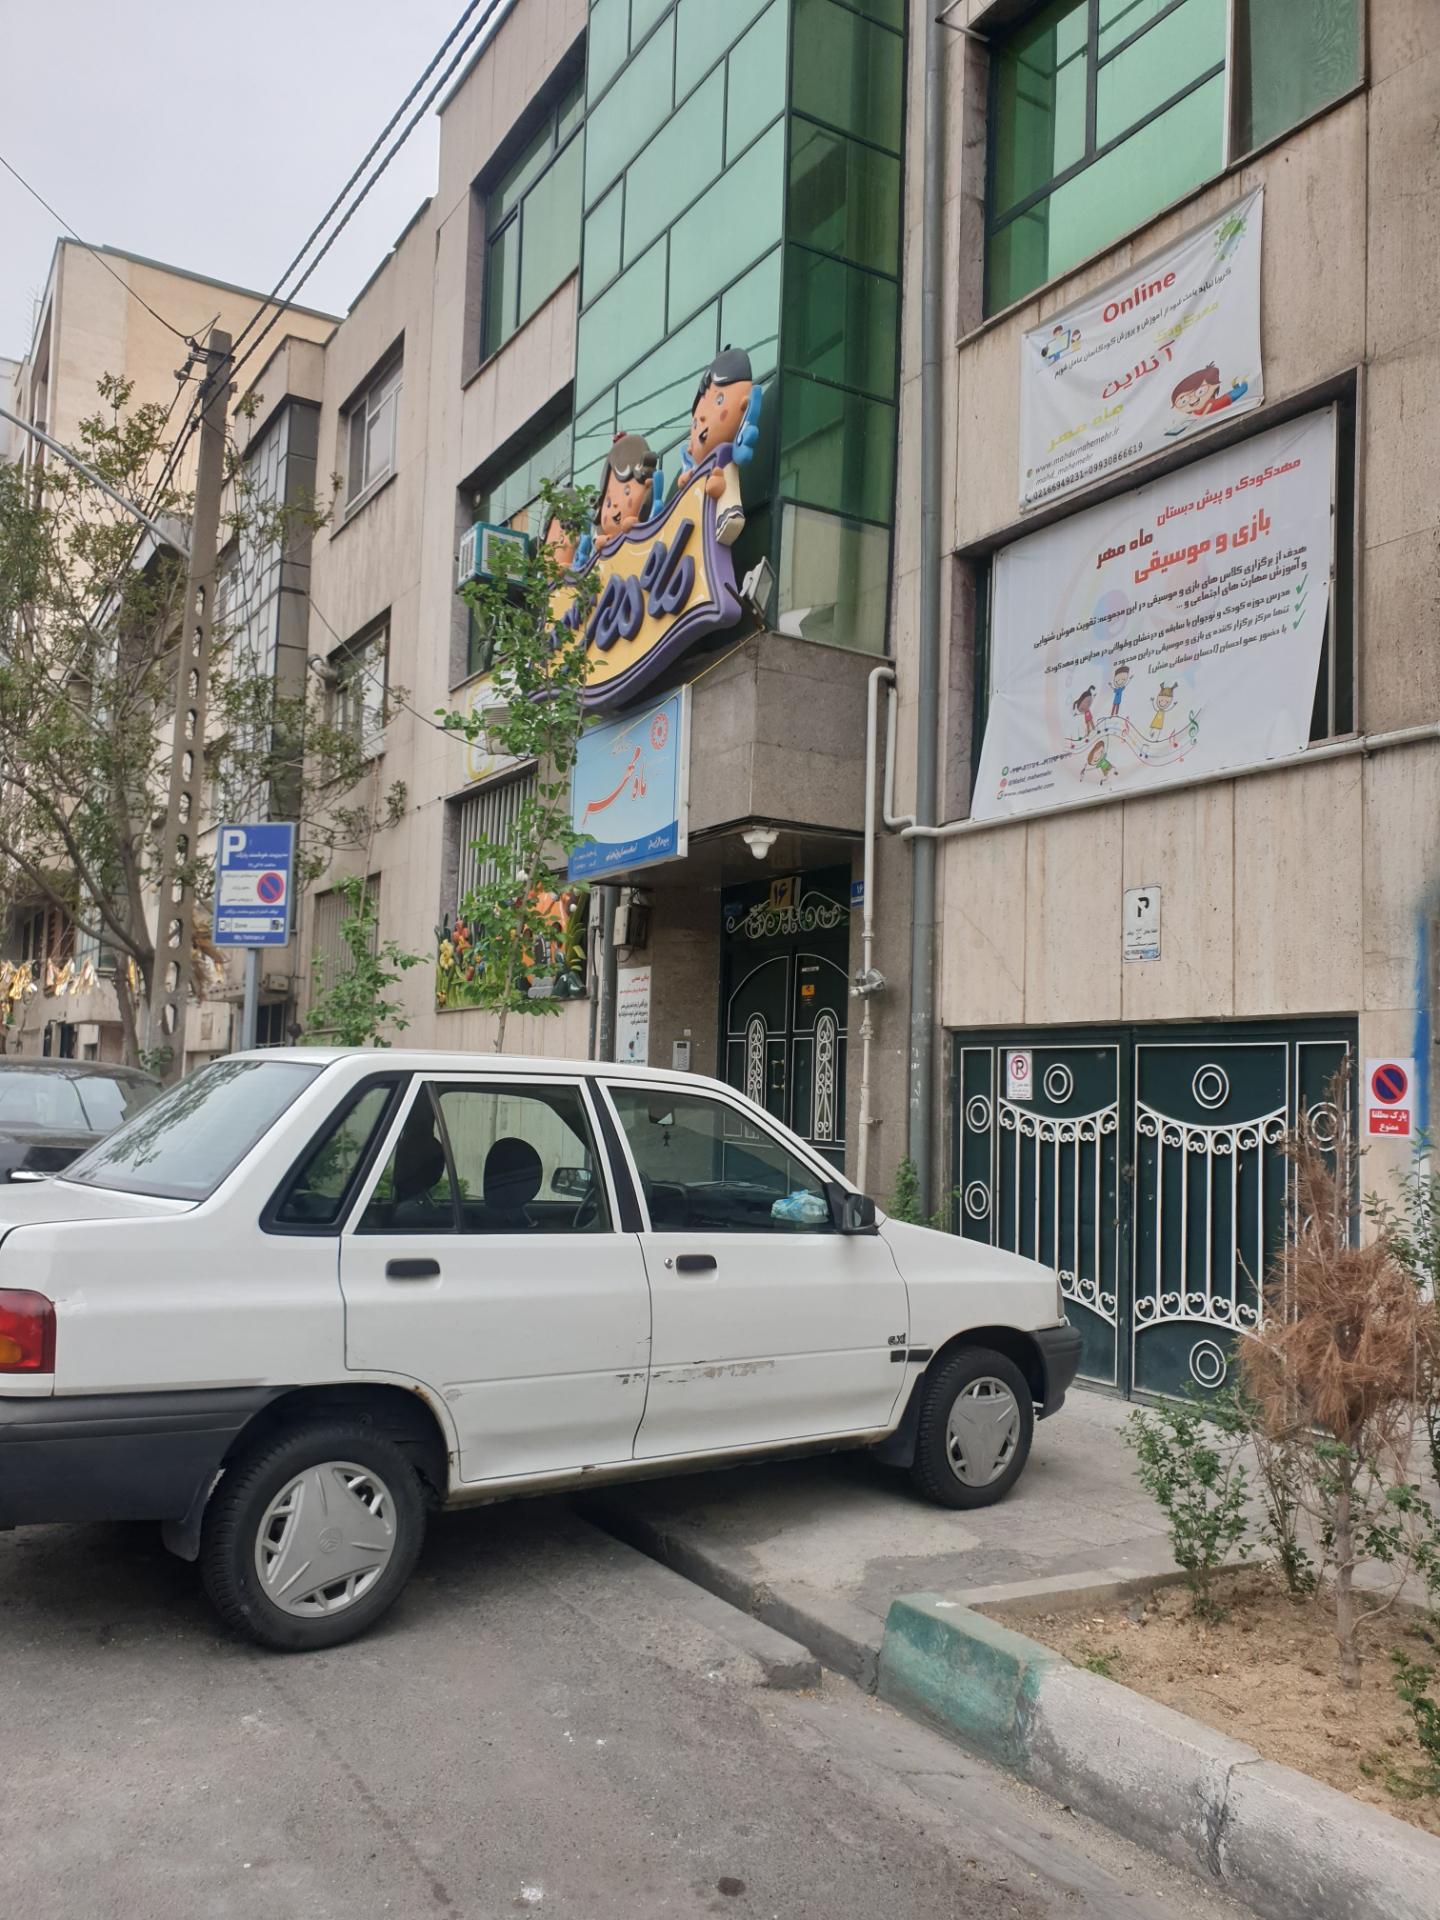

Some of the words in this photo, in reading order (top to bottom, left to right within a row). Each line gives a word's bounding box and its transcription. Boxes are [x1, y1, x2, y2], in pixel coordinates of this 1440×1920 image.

[1198, 281, 1213, 293] نباید
[1103, 272, 1175, 322] Online
[1141, 308, 1162, 329] آموزش
[1116, 328, 1135, 343] پرورش
[1102, 339, 1174, 398] آنلاین
[1092, 403, 1123, 424] ماه
[1049, 424, 1085, 451] مهر
[1235, 459, 1300, 490] مهدکودک
[1196, 489, 1222, 510] پیش
[1225, 486, 1232, 499] و
[1157, 502, 1193, 526] دبستان
[1232, 508, 1270, 547] بازی
[1129, 528, 1152, 550] ماه
[1215, 533, 1227, 554] و
[1096, 544, 1125, 569] مهر
[1275, 550, 1281, 564] از
[1283, 546, 1306, 558] هدف
[640, 518, 695, 619] ماه
[1134, 540, 1210, 583] موسیقی
[1243, 556, 1272, 574] برگزاری
[1269, 556, 1300, 580] آموزش
[1301, 561, 1307, 570] و
[1219, 565, 1242, 583] کلاس
[1240, 574, 1267, 587] مهارت
[1184, 579, 1199, 594] بازی
[1201, 575, 1217, 589] های
[1221, 582, 1238, 596] های
[1147, 591, 1177, 608] موسیقی
[1178, 588, 1184, 597] و
[1190, 585, 1220, 606] اجتماعی
[1265, 589, 1290, 603] مدرس
[1125, 601, 1137, 615] این
[1138, 602, 1145, 611] در
[1184, 600, 1189, 609] و
[1222, 601, 1245, 614] کودک
[1246, 598, 1264, 608] حوزه
[1272, 604, 1289, 616] تنها
[1076, 616, 1096, 630] تقویت
[1191, 613, 1215, 627] نوجوان
[1233, 617, 1252, 630] برگزار
[1254, 612, 1271, 624] مرکز
[1056, 627, 1075, 640] هوش
[1165, 621, 1184, 633] سابقه
[1212, 623, 1232, 634] کننده
[1033, 632, 1055, 648] شنوایی
[1190, 631, 1204, 644] بازی
[1242, 635, 1257, 646] عمو
[1258, 629, 1279, 641] حضور
[1155, 640, 1183, 654] موسیقی
[1219, 636, 1242, 653] احسان
[1079, 651, 1099, 664] مدارس
[1113, 655, 1136, 666] محدوده
[1044, 660, 1074, 673] مهدکودک
[222, 830, 247, 866] P
[1371, 1110, 1390, 1119] مطلقا
[1390, 1111, 1408, 1122] پارک
[1379, 1123, 1399, 1133] ممنوع
